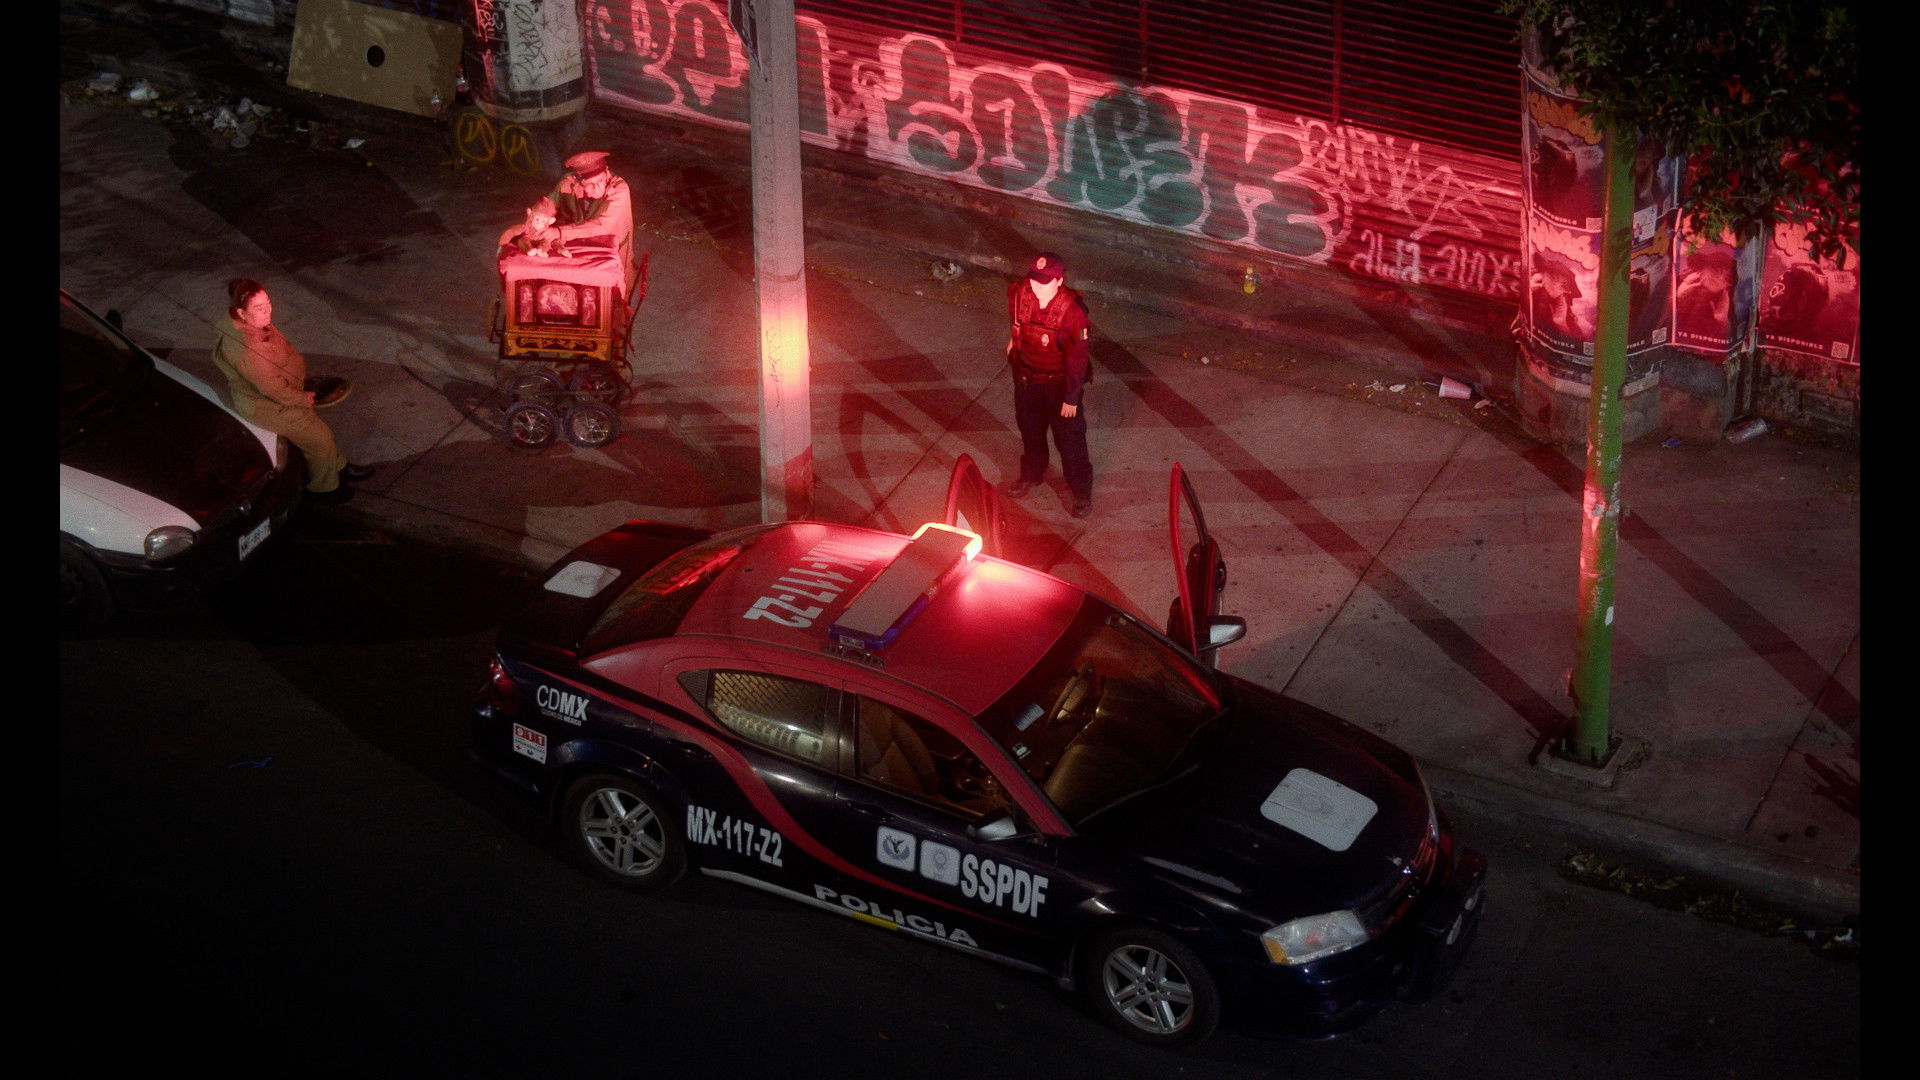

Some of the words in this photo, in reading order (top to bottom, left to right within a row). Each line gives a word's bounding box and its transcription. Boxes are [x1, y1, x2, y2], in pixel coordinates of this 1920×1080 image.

[1777, 336, 1824, 350] DISPONIBLE
[537, 685, 589, 721] CDMX
[687, 804, 783, 868] MX-117-Z2
[813, 884, 979, 947] POLICIA
[961, 854, 1049, 918] SSPDF
